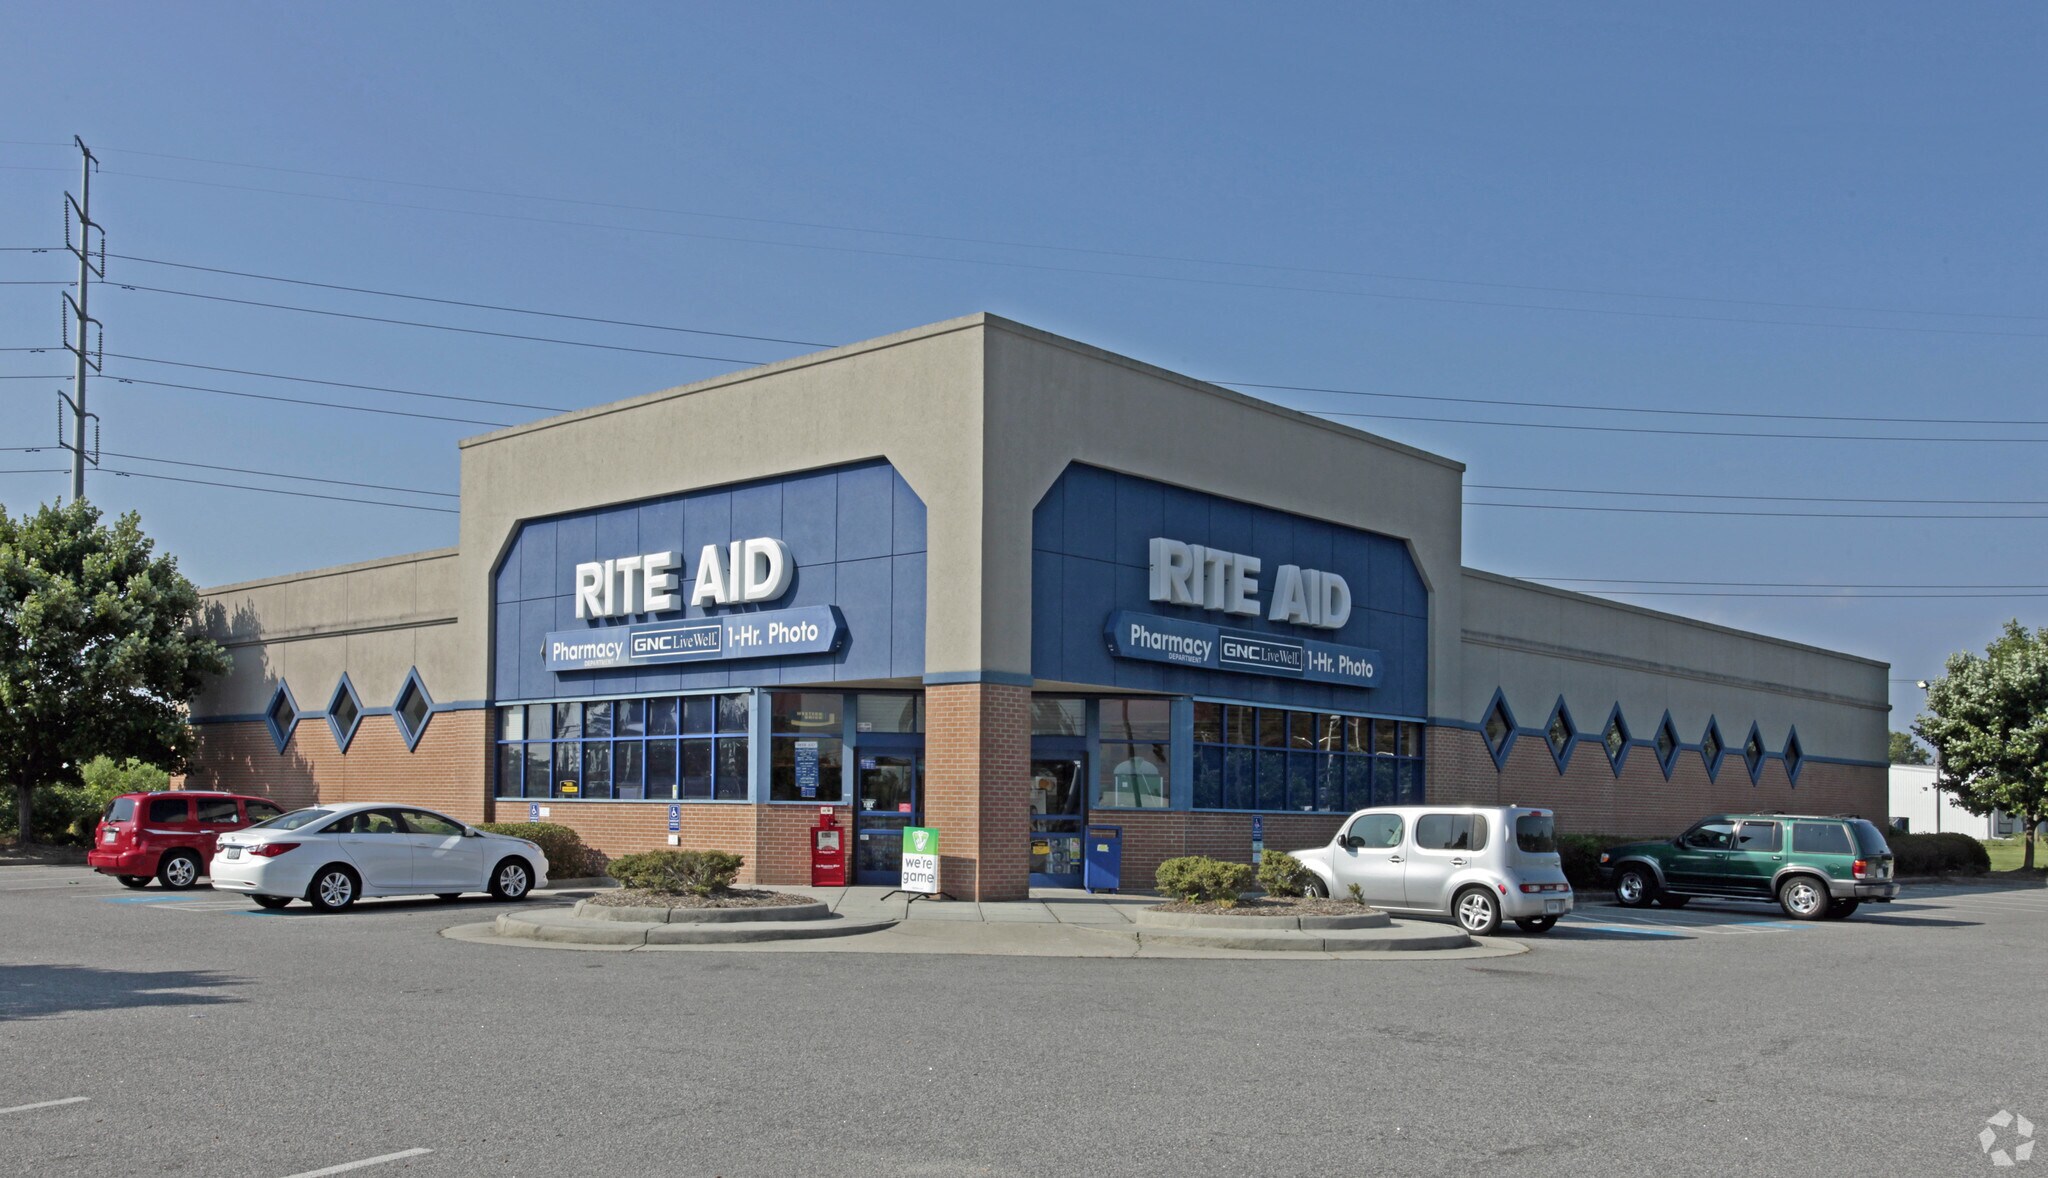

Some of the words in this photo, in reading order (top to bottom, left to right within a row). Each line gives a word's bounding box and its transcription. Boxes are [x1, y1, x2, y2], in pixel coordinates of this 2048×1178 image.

[576, 551, 682, 619] RITE
[691, 537, 794, 607] AID
[1149, 537, 1261, 616] RITE
[1268, 564, 1351, 629] AID
[553, 641, 624, 661] Pharmacy
[634, 636, 672, 652] GNC
[728, 625, 763, 648] 1-Hr.
[768, 621, 819, 645] Photo
[1131, 623, 1212, 662] Pharmacy
[1223, 642, 1260, 661] GNC
[1307, 650, 1335, 673] 1-Hr.
[1339, 654, 1374, 678] Photo
[584, 658, 614, 667] DEPARTMENT
[1168, 652, 1202, 664] DEPARTMENT
[905, 856, 933, 869] we're
[902, 871, 935, 884] game
